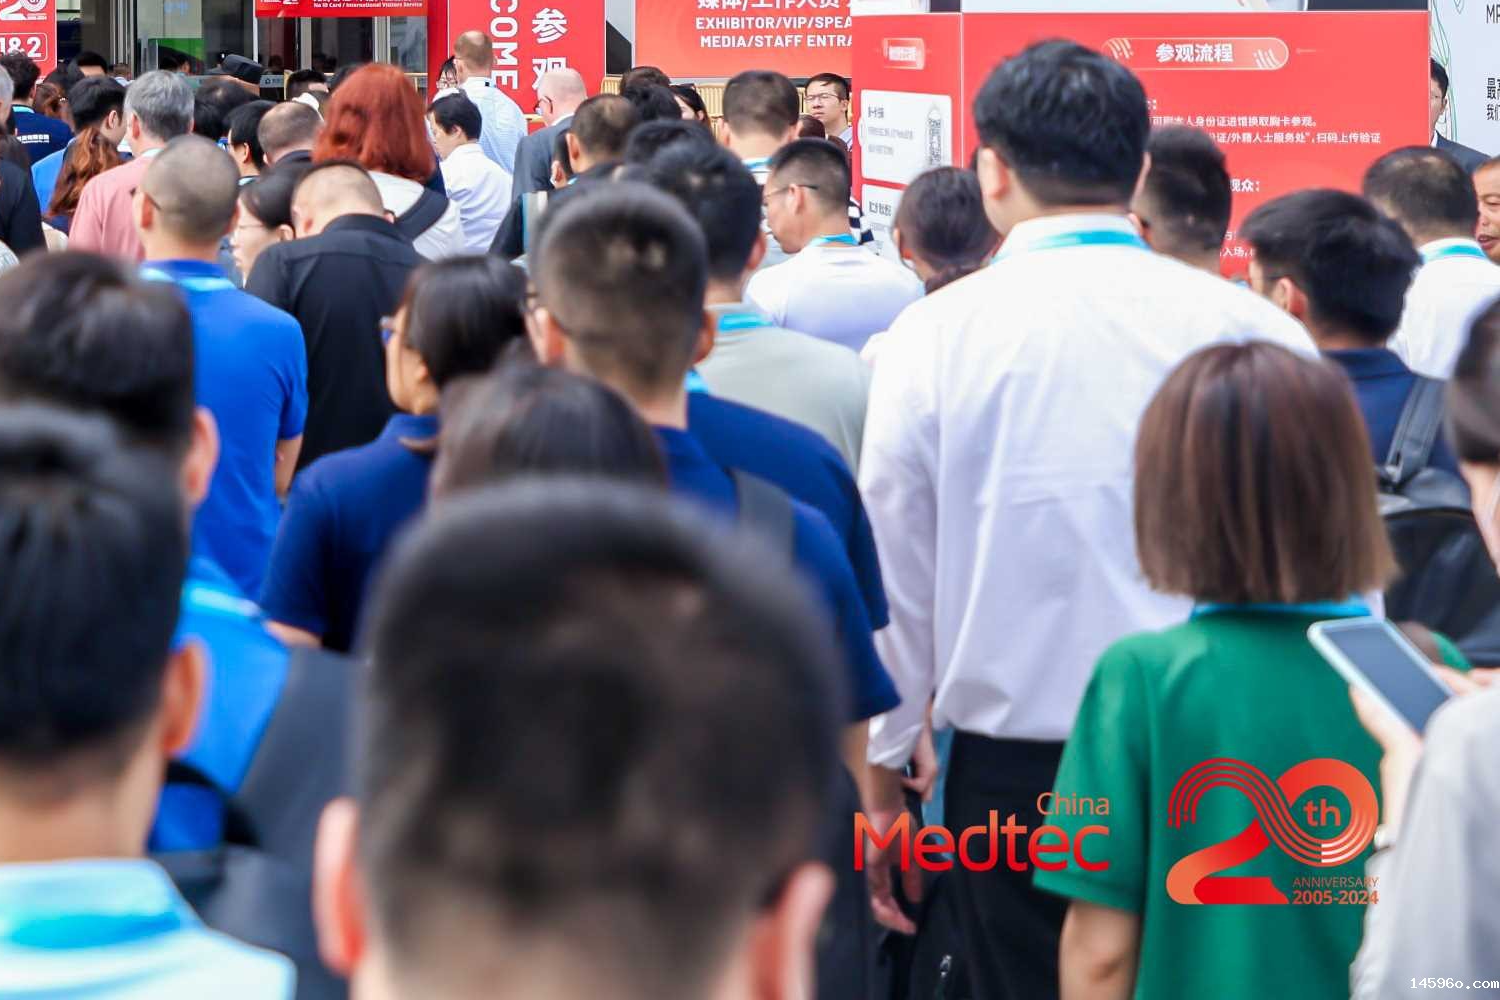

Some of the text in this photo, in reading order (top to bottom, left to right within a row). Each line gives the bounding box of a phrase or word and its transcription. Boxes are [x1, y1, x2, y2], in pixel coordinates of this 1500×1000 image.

[700, 34, 802, 48] MEDIA/STAFF
[1156, 43, 1234, 63] 参观流程
